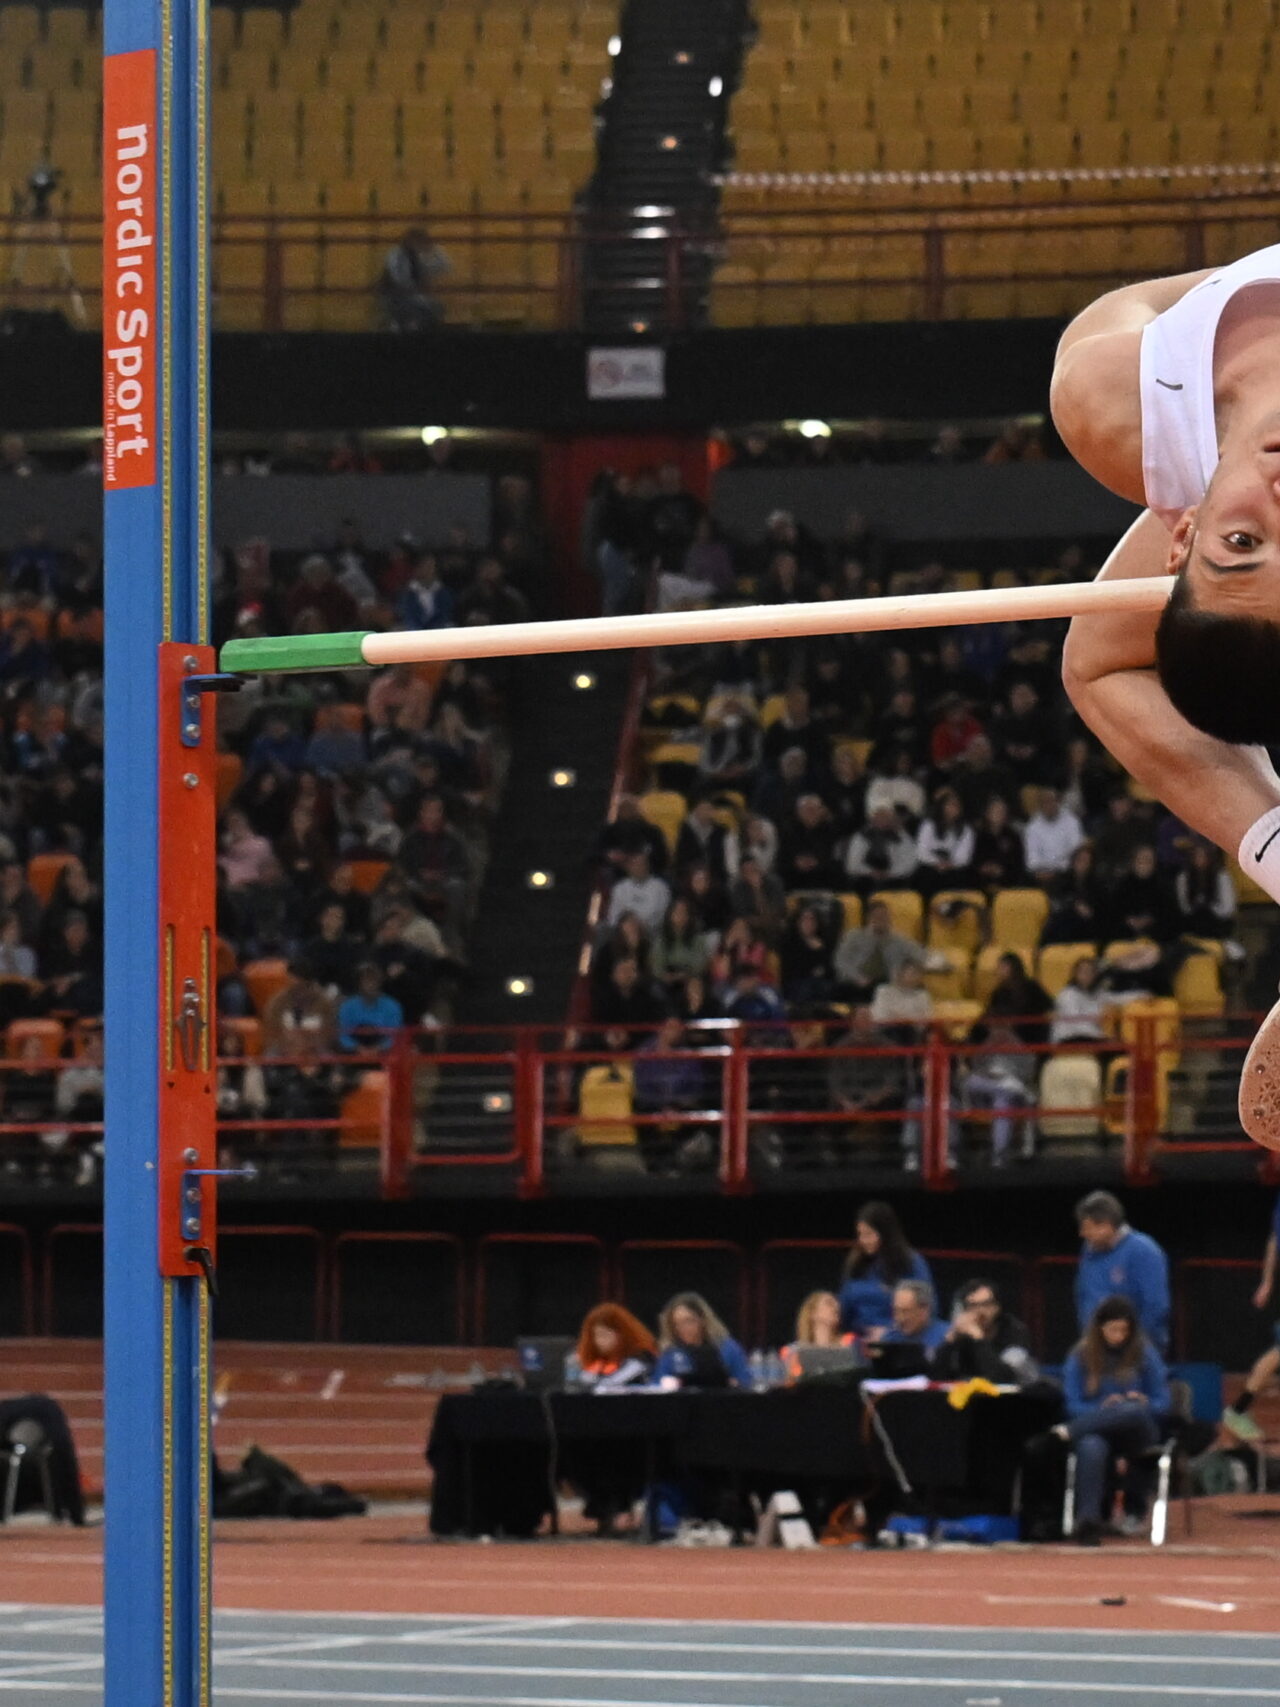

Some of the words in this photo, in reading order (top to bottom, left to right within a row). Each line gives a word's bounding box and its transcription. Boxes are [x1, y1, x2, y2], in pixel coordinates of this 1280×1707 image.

[116, 124, 153, 298] nordic
[106, 371, 115, 406] made
[107, 308, 150, 459] Sport
[105, 423, 117, 482] Lappland
